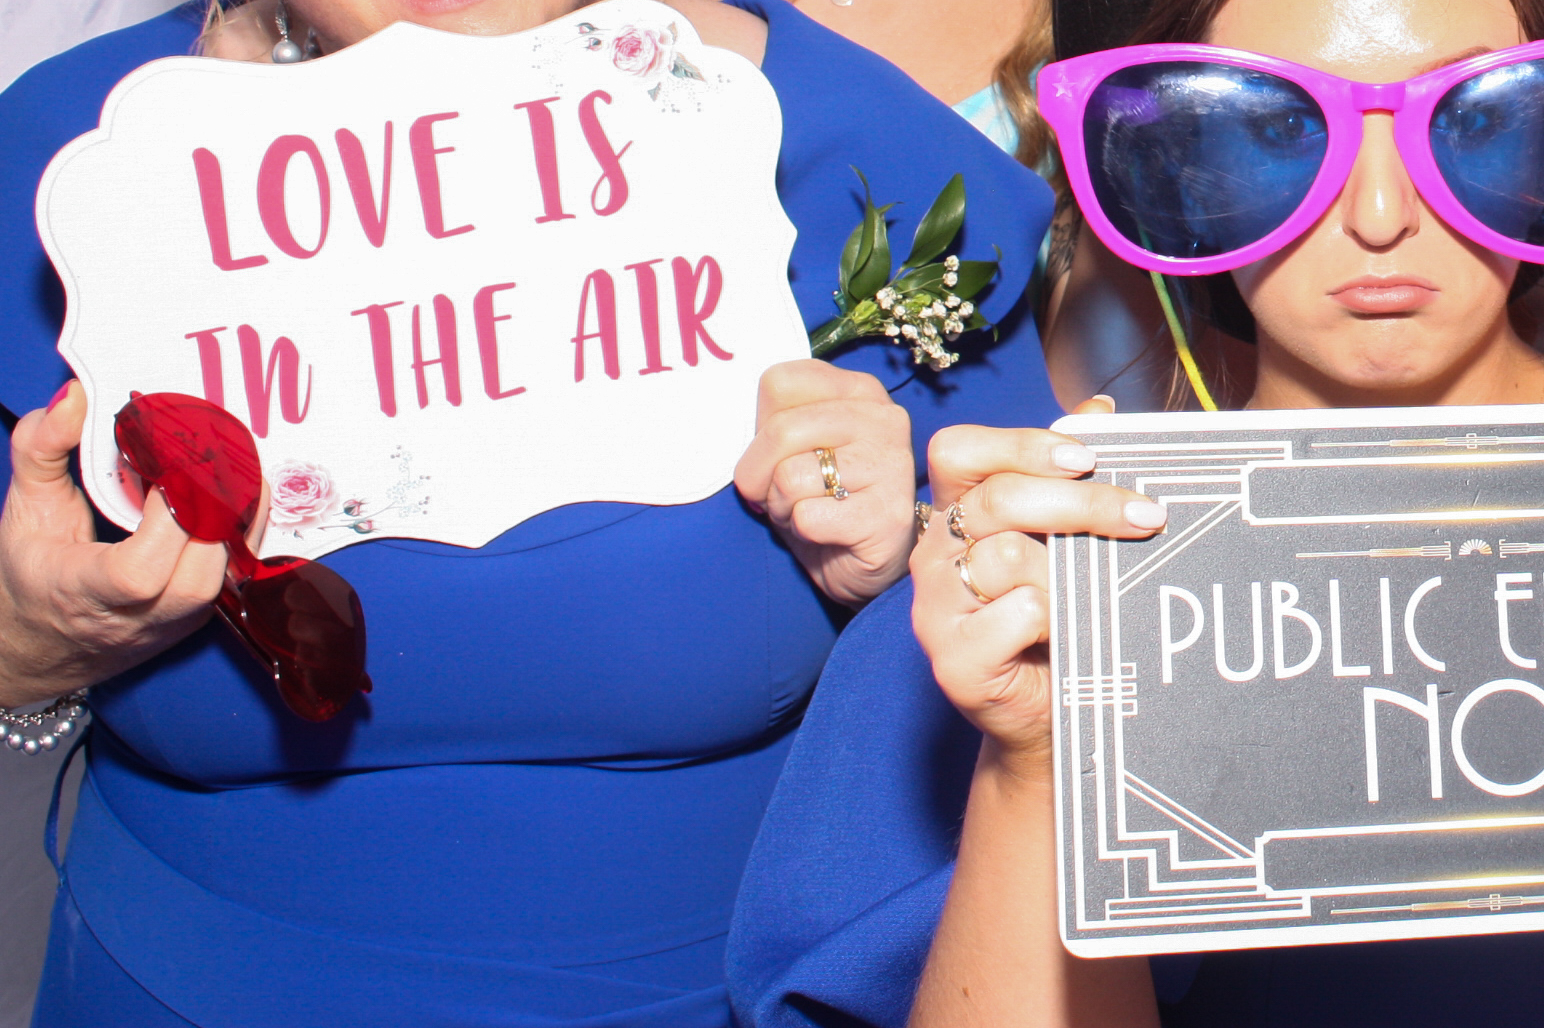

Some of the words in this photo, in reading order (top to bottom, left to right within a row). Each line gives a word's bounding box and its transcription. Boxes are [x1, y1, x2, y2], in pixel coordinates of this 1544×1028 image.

[191, 110, 475, 272] LOVE
[513, 88, 633, 224] IS
[350, 281, 527, 418] THE
[570, 254, 734, 381] AIR
[1158, 575, 1447, 685] PUBLIC
